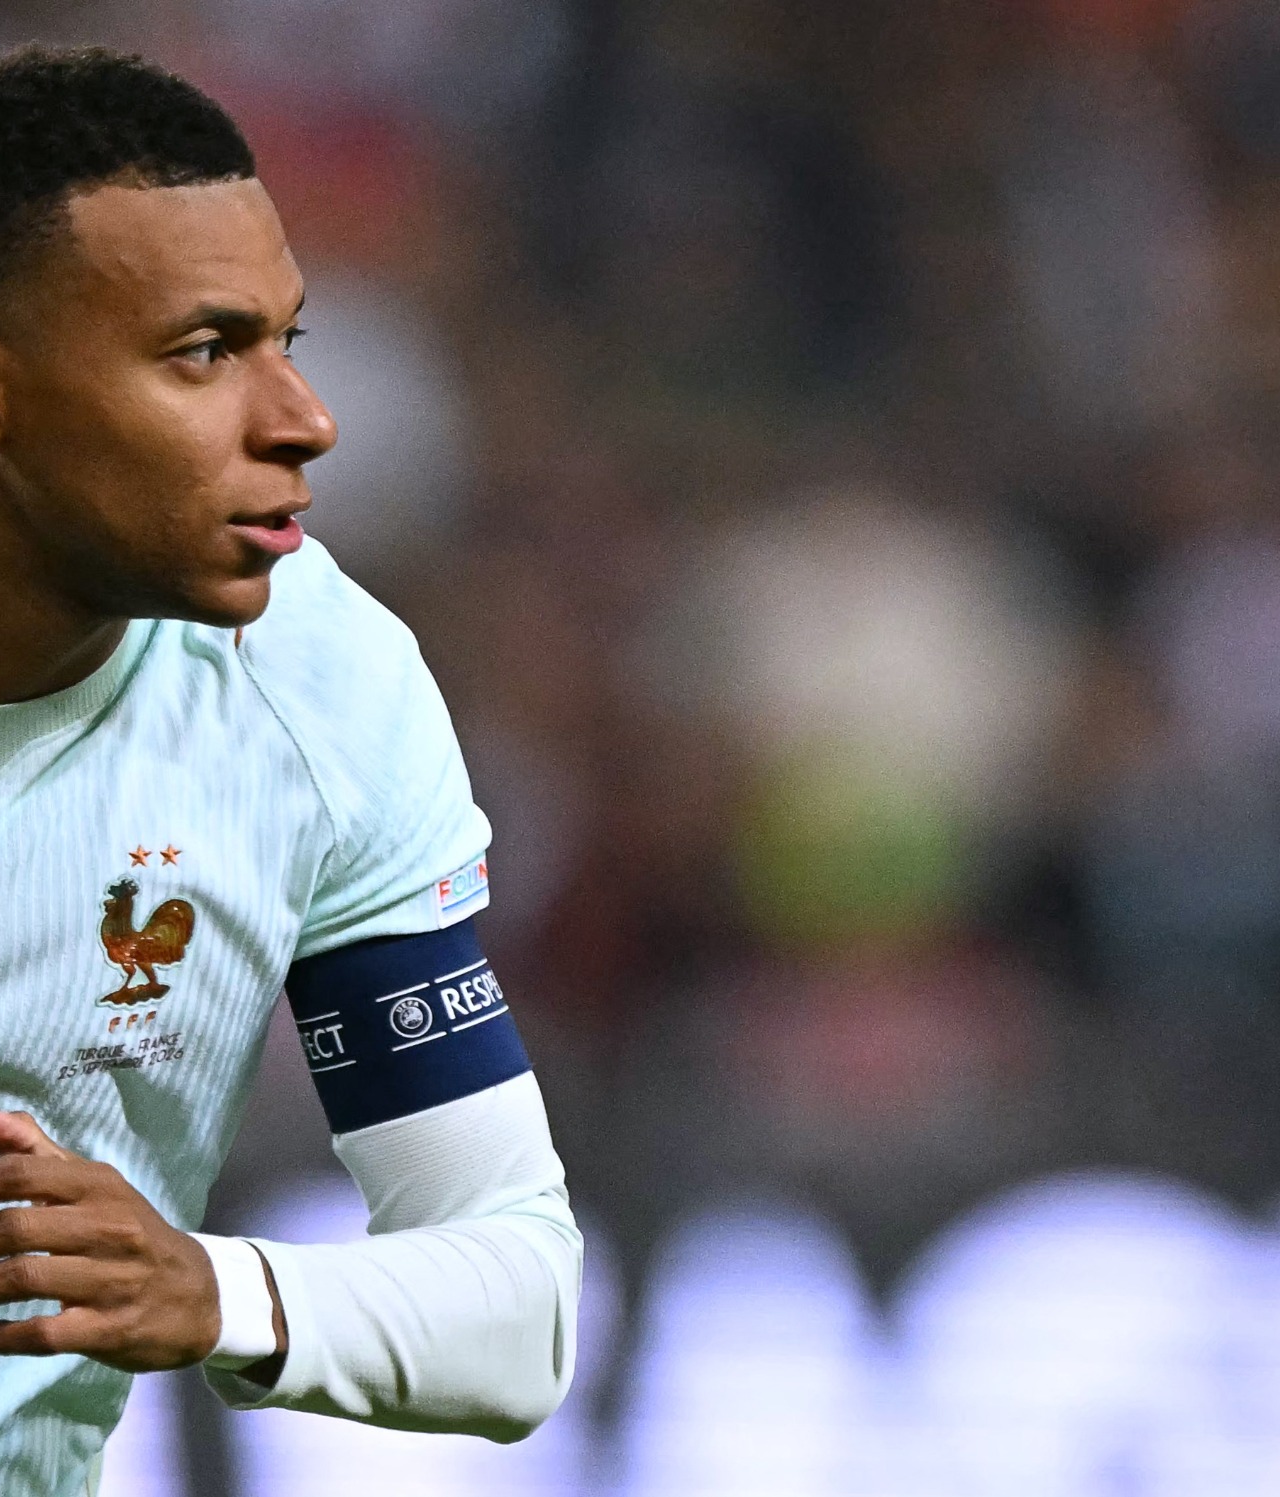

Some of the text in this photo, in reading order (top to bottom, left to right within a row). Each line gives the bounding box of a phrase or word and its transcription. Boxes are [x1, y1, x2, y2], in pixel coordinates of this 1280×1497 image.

[395, 1000, 420, 1013] UEFA
[76, 1043, 126, 1061] TURQUIE
[138, 1032, 181, 1053] FRANCE
[57, 1064, 78, 1080] 25
[148, 1047, 184, 1066] 2026
